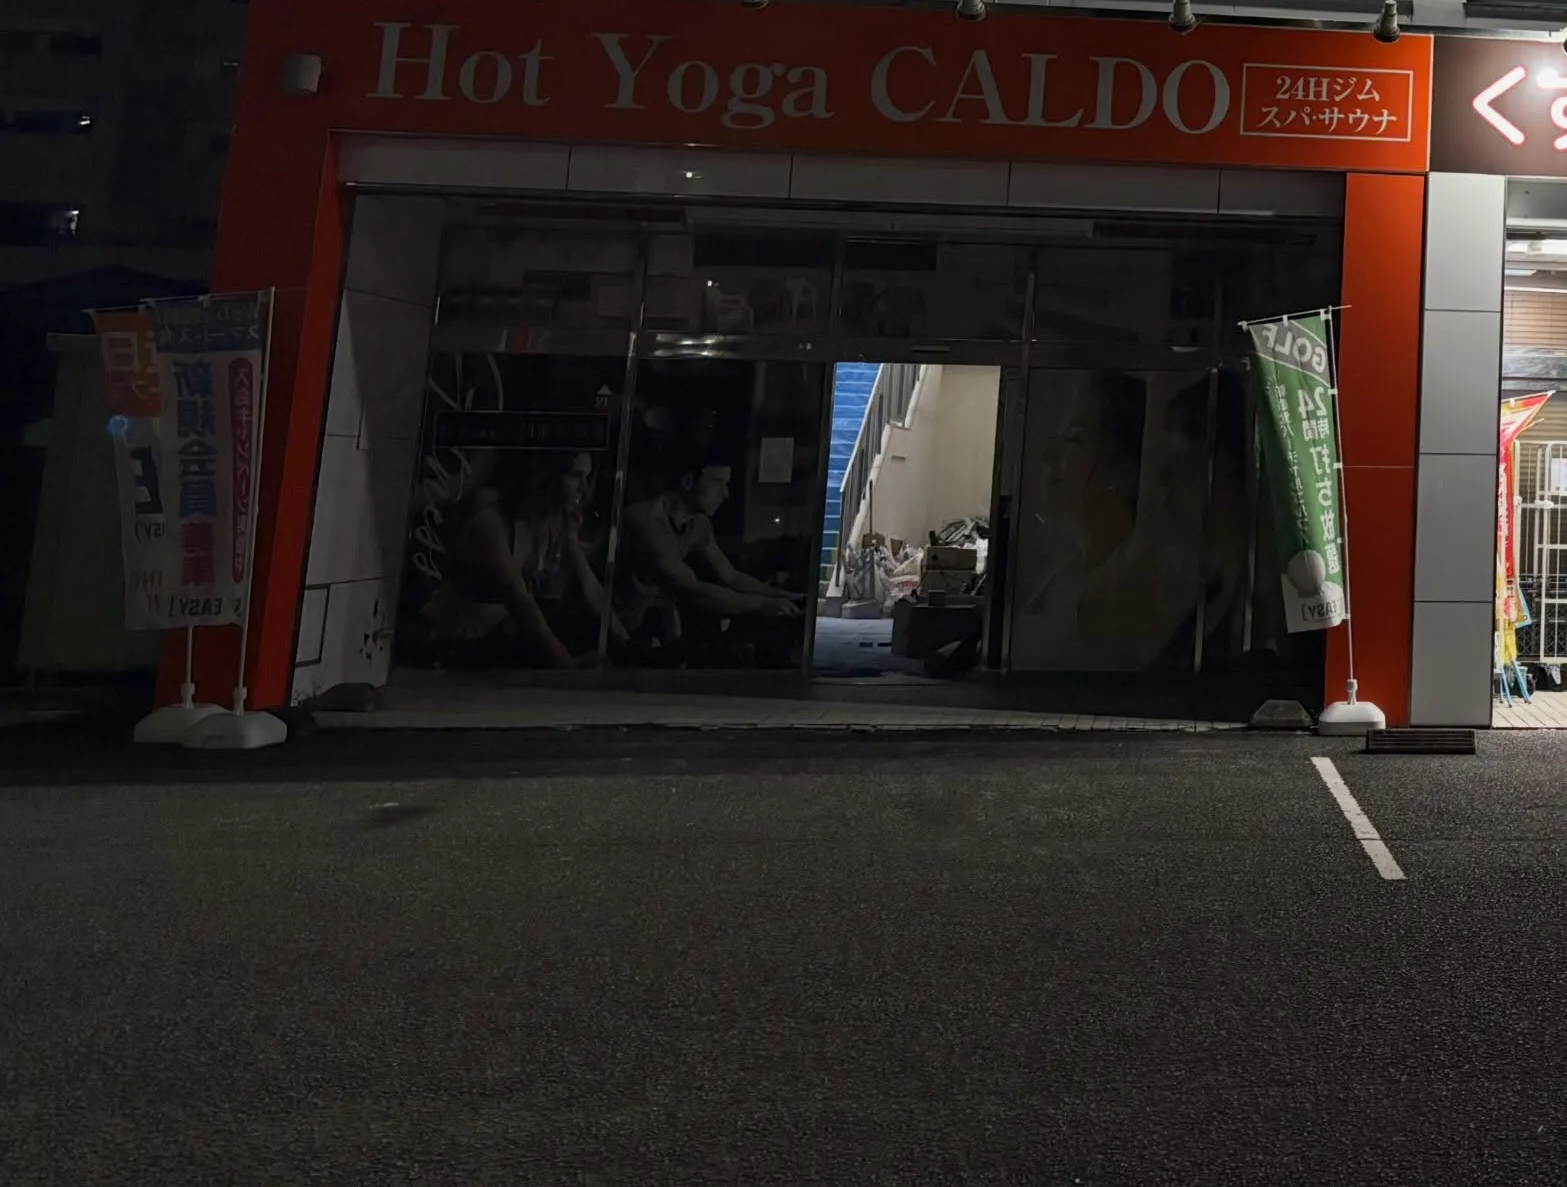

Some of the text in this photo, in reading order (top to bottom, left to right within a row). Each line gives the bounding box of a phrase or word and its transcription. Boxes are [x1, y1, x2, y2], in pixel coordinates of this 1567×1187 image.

[366, 21, 1231, 135] Hot Yoga CALDO
[1275, 75, 1380, 103] 24Hジム
